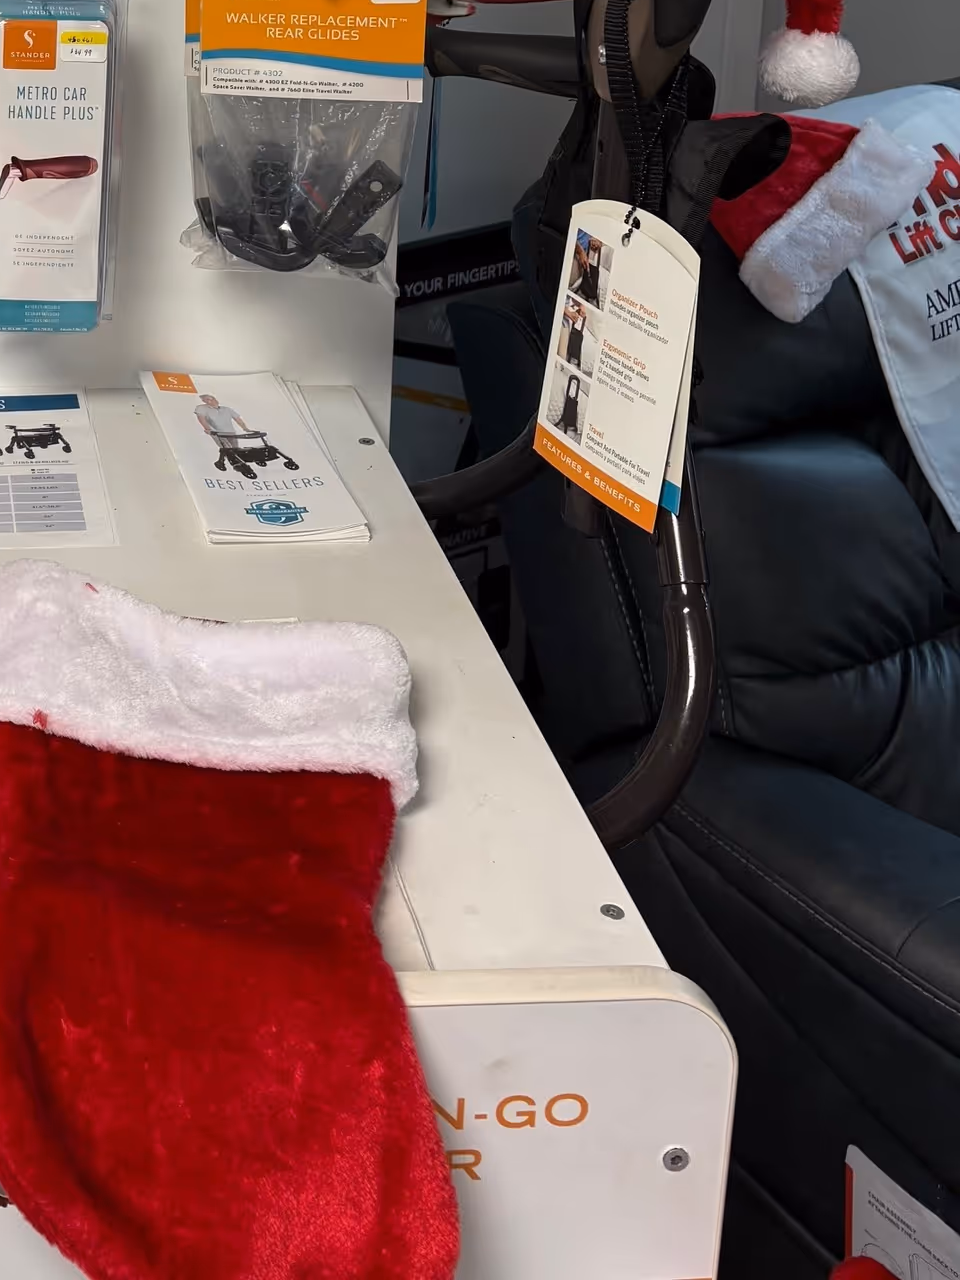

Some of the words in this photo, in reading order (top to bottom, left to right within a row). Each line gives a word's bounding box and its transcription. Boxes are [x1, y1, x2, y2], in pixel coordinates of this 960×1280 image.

[226, 12, 286, 25] WALKER
[266, 27, 304, 39] REAR
[308, 28, 359, 41] GLIDES
[213, 67, 251, 76] PRODUCT
[17, 86, 58, 101] METRO
[64, 87, 87, 101] CAR
[8, 105, 56, 120] HANDLE
[405, 277, 443, 298] YOUR
[610, 298, 628, 313] Includes
[645, 317, 659, 330] pouch
[611, 288, 639, 310] Organizer
[639, 304, 659, 320] Pouch
[603, 339, 632, 362] Ergonomic
[632, 357, 647, 371] Grip
[609, 363, 624, 378] handed
[623, 371, 633, 383] grip
[621, 358, 636, 375] handle
[635, 367, 650, 382] allows
[588, 423, 605, 440] Travel
[584, 441, 603, 459] Compacto
[621, 466, 632, 478] para
[586, 432, 603, 451] Compact
[602, 443, 612, 455] And
[611, 448, 629, 466] Portable
[628, 459, 637, 470] For
[636, 463, 651, 478] Travel
[204, 478, 246, 491] BEST
[252, 476, 325, 491] SELLERS
[542, 438, 583, 474] FEATURES
[584, 470, 592, 481] &
[593, 477, 641, 513] BENEFITS
[868, 1190, 886, 1209] CHAIR
[886, 1206, 917, 1234] ASSEMBLY
[867, 1199, 901, 1231] ATTACHING
[900, 1227, 914, 1240] THE
[913, 1237, 932, 1256] CHAIR
[932, 1253, 949, 1269] BACK
[949, 1266, 960, 1278] TO
